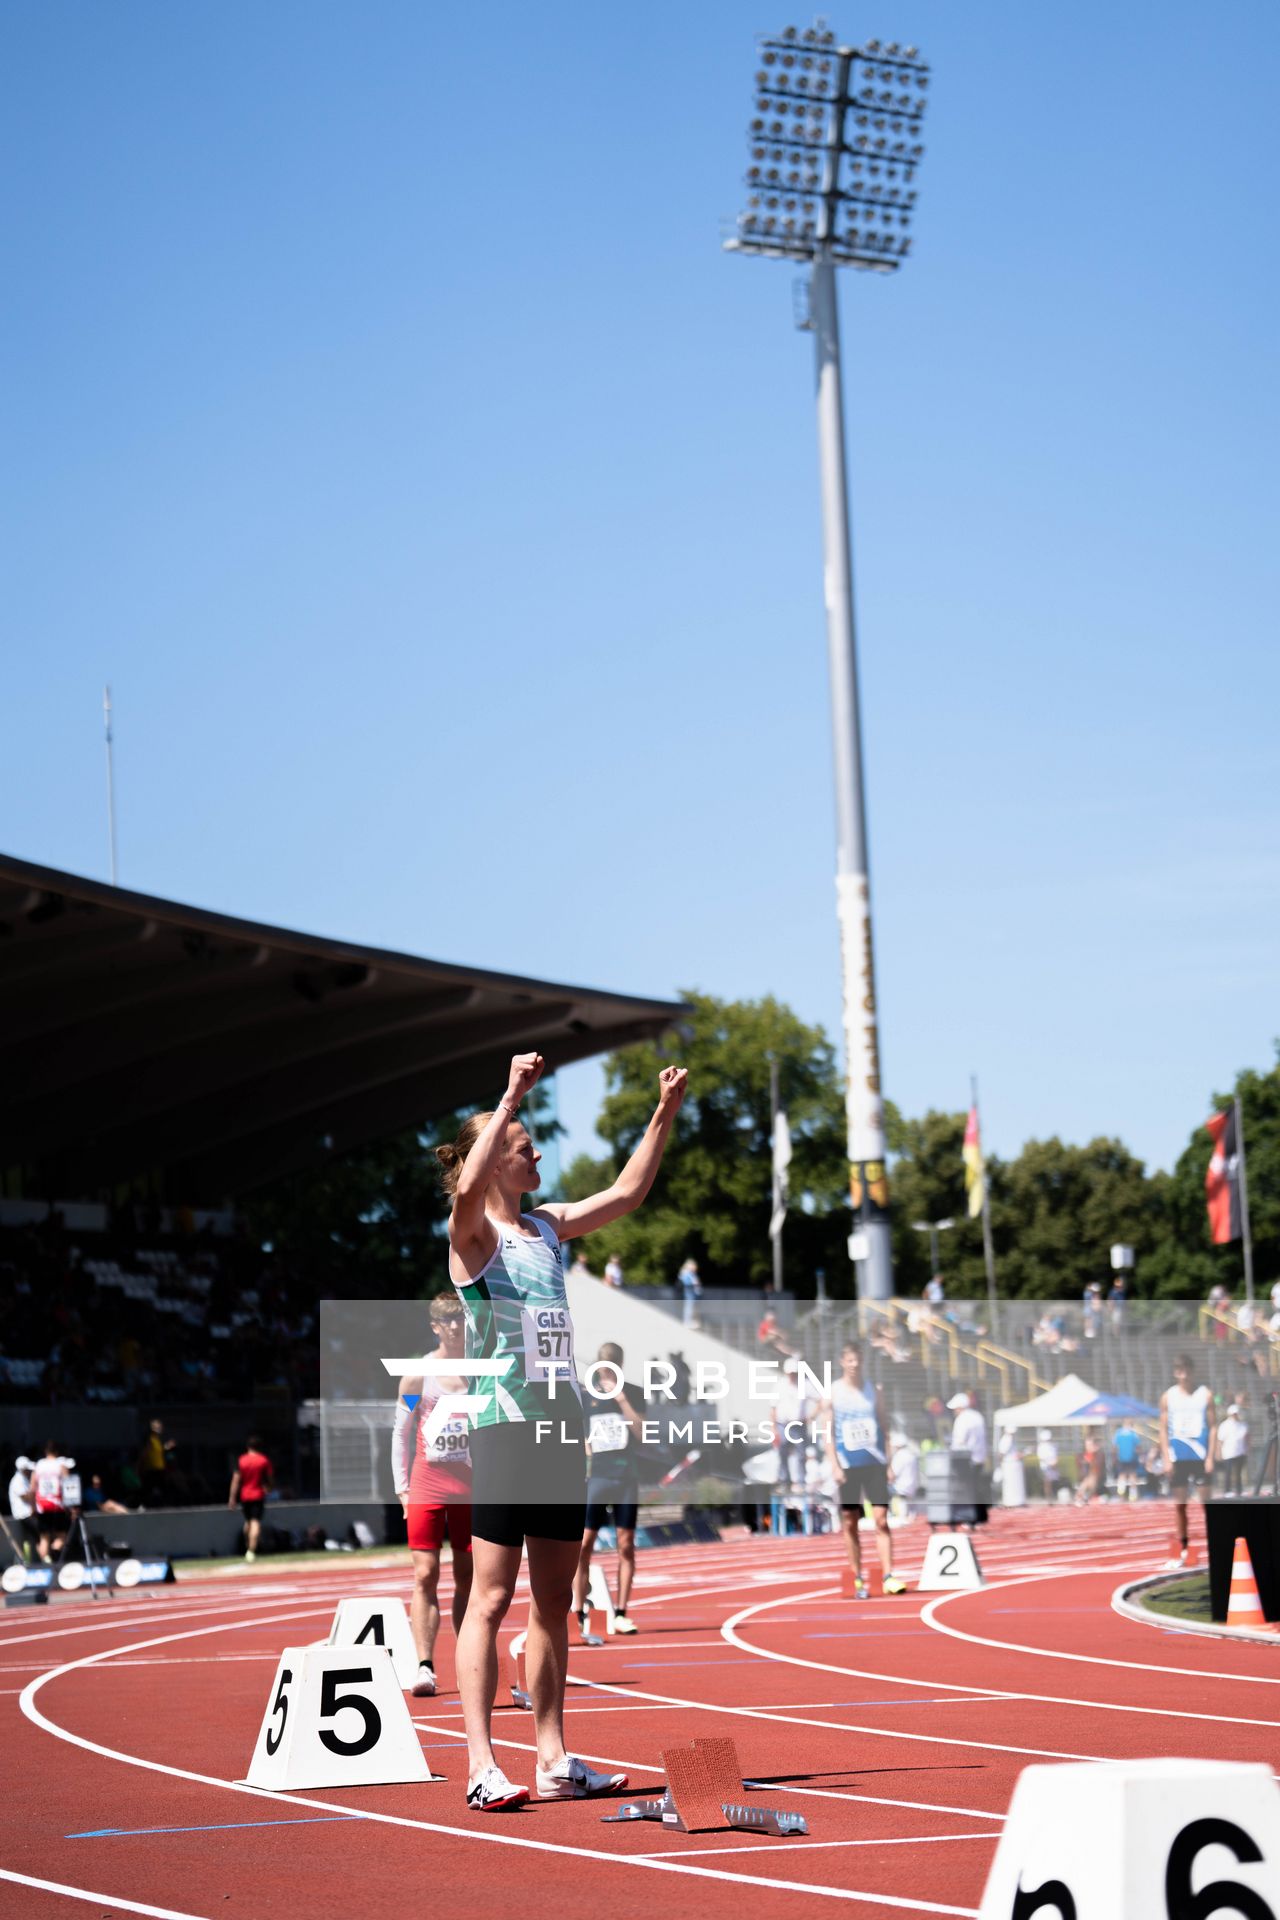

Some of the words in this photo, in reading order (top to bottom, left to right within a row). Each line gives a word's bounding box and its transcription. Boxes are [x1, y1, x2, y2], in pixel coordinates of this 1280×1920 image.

[537, 1311, 566, 1328] GLS
[536, 1331, 571, 1358] 577
[440, 1422, 463, 1433] LS
[435, 1434, 469, 1451] 990
[939, 1545, 960, 1576] 2
[266, 1669, 293, 1756] 5
[318, 1667, 382, 1756] 5
